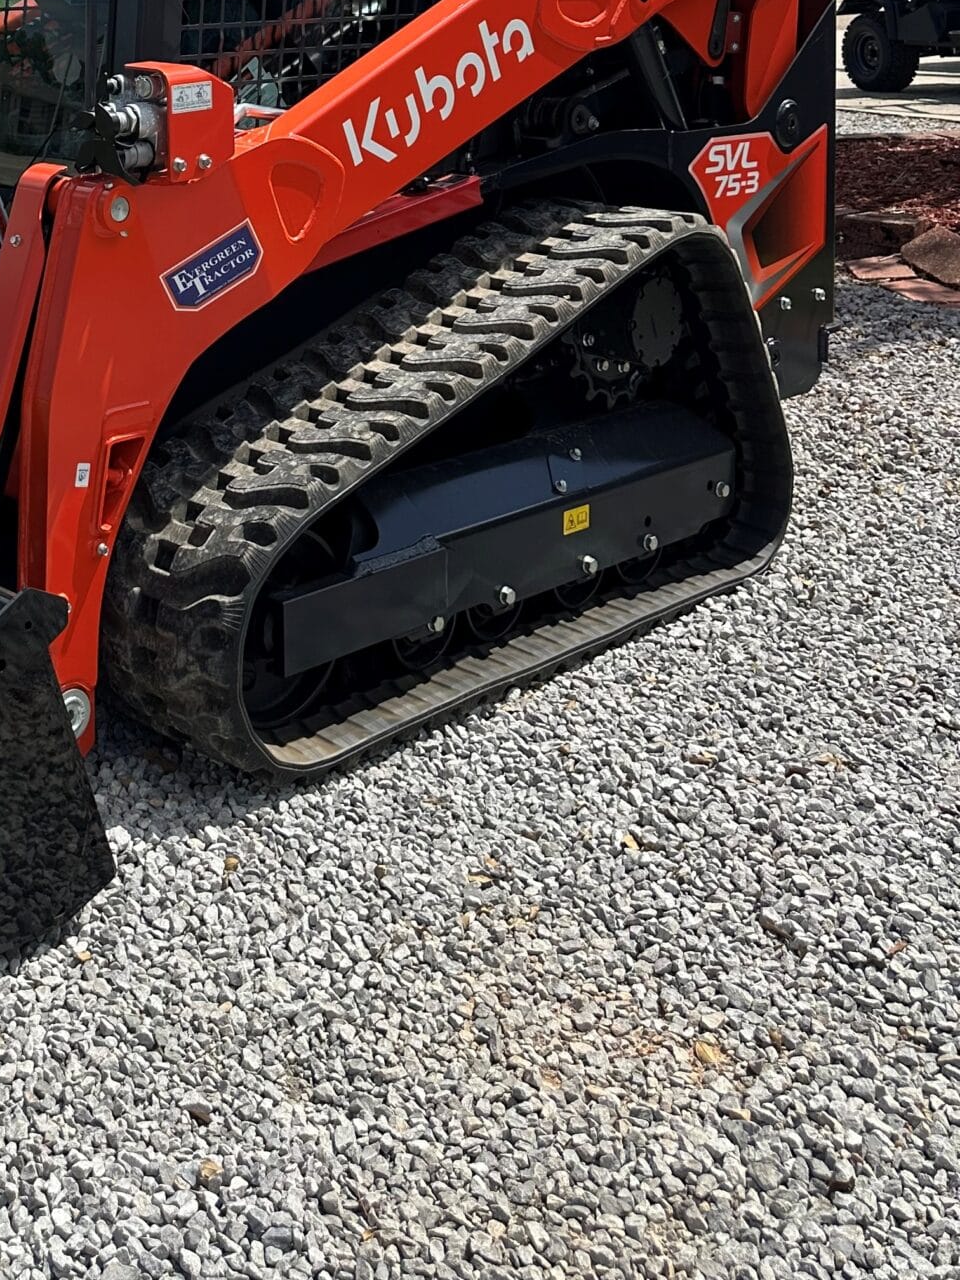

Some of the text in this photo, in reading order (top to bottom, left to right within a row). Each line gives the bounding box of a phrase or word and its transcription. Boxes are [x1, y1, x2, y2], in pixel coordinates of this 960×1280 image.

[342, 18, 535, 166] Kubota
[705, 141, 758, 174] SVL
[714, 170, 760, 199] 75-3
[171, 236, 247, 294] EVERGREEN
[193, 248, 255, 298] TRACTOR
